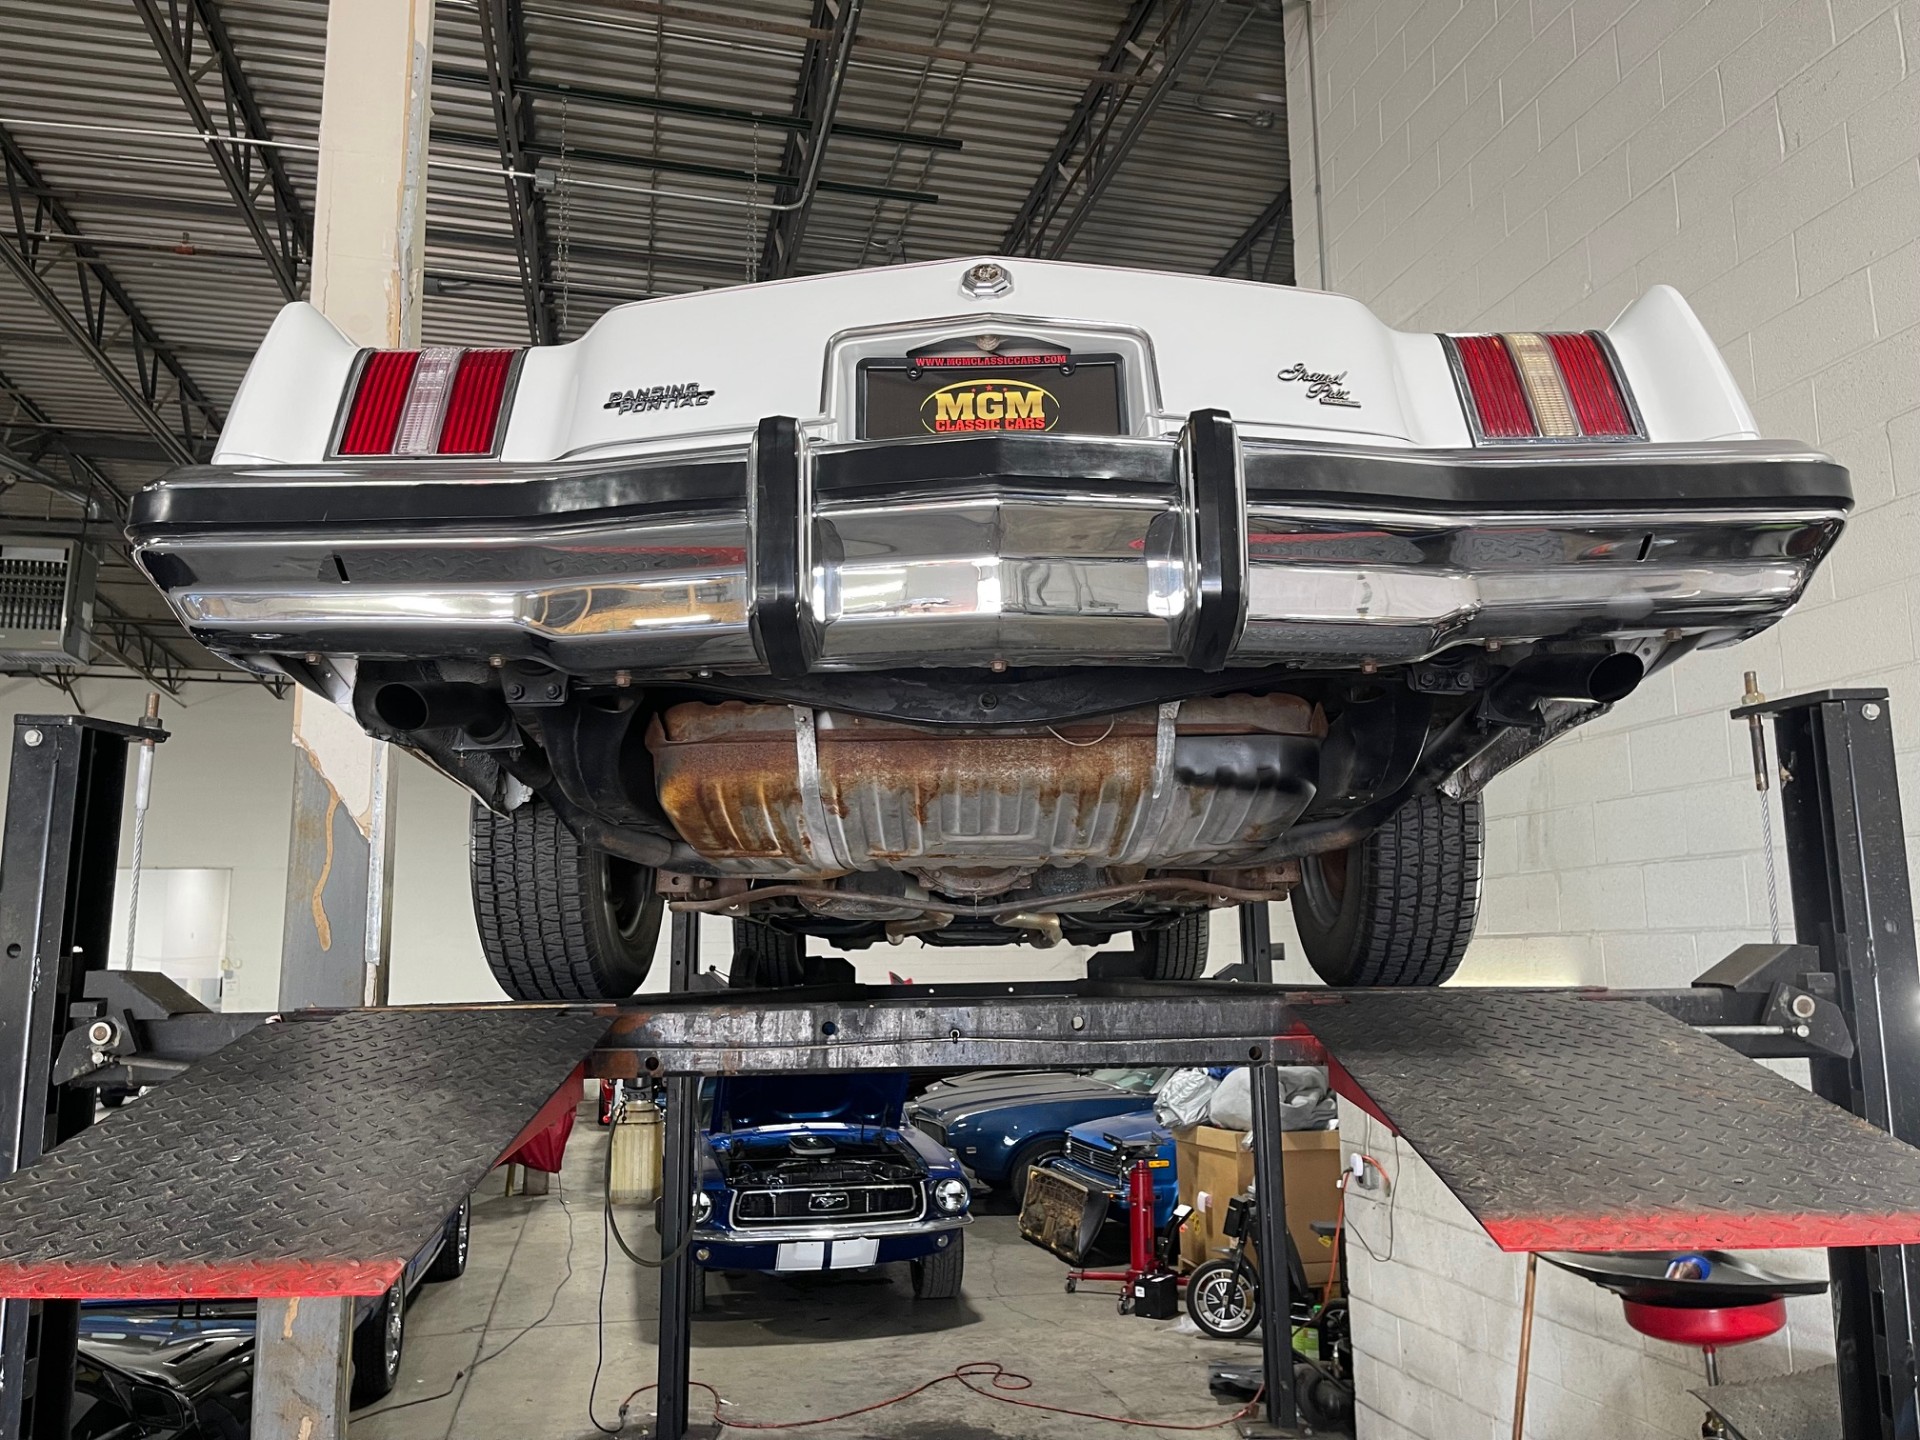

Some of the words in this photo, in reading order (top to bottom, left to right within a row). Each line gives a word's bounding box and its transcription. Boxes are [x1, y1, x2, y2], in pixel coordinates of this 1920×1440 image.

[915, 355, 1067, 367] WWW.MGMCLASSICCARS.COM
[1277, 362, 1349, 386] Grand
[1305, 381, 1351, 401] Prix
[618, 394, 712, 416] PONTIAC
[935, 390, 1046, 421] MGM
[935, 419, 1001, 432] CLASSIC
[1004, 417, 1046, 431] CARS
